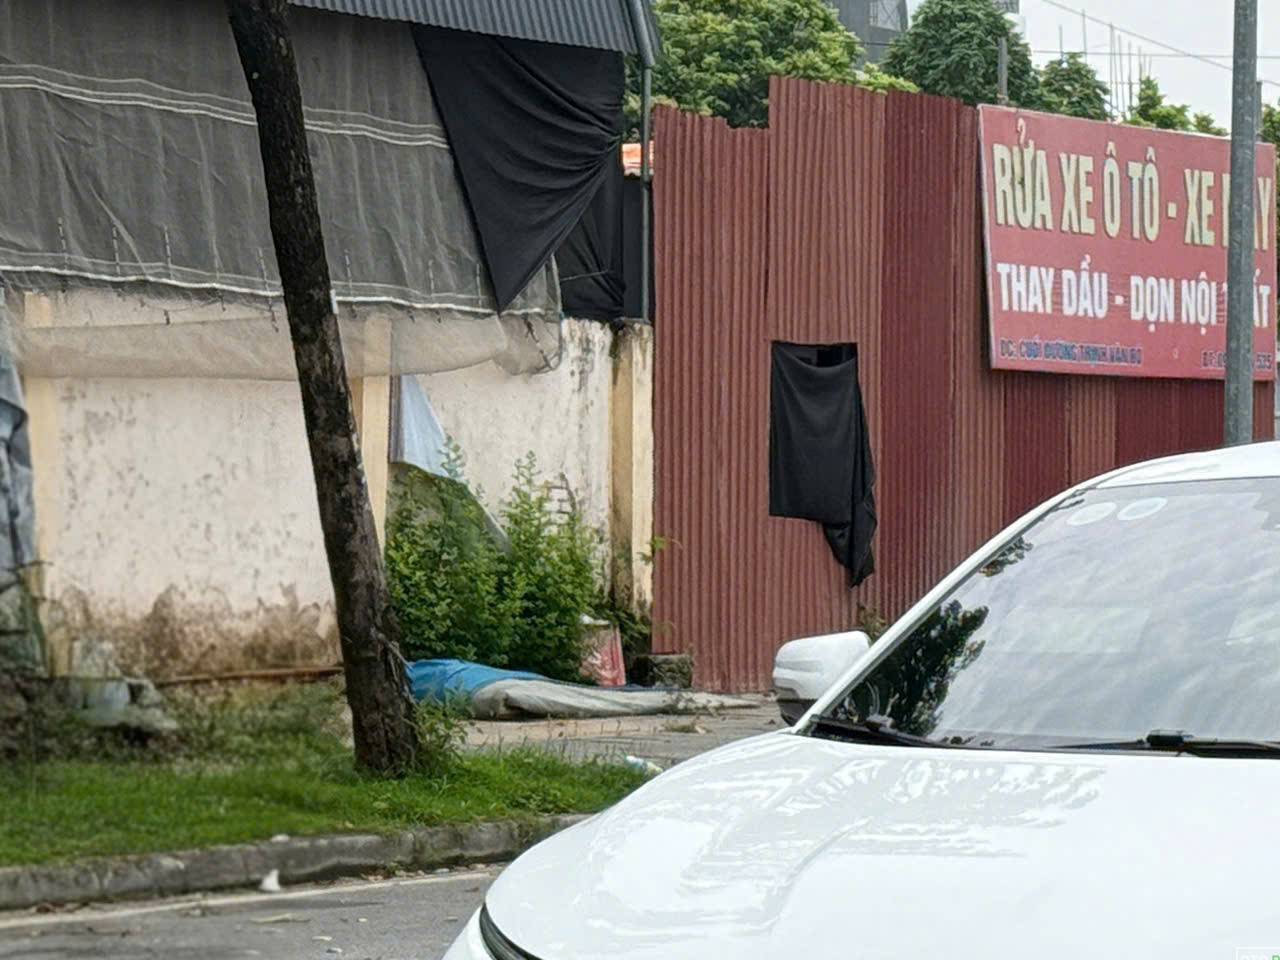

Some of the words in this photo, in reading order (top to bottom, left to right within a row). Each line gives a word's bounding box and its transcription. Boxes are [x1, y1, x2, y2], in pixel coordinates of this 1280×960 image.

[993, 118, 1054, 231] RỬA
[1060, 152, 1096, 235] XE
[1103, 141, 1122, 238] Ô
[1127, 146, 1160, 242] TÔ
[1184, 168, 1216, 247] XE
[996, 263, 1055, 314] THAY
[1130, 275, 1175, 333] DỌN
[1181, 271, 1218, 336] NỘI
